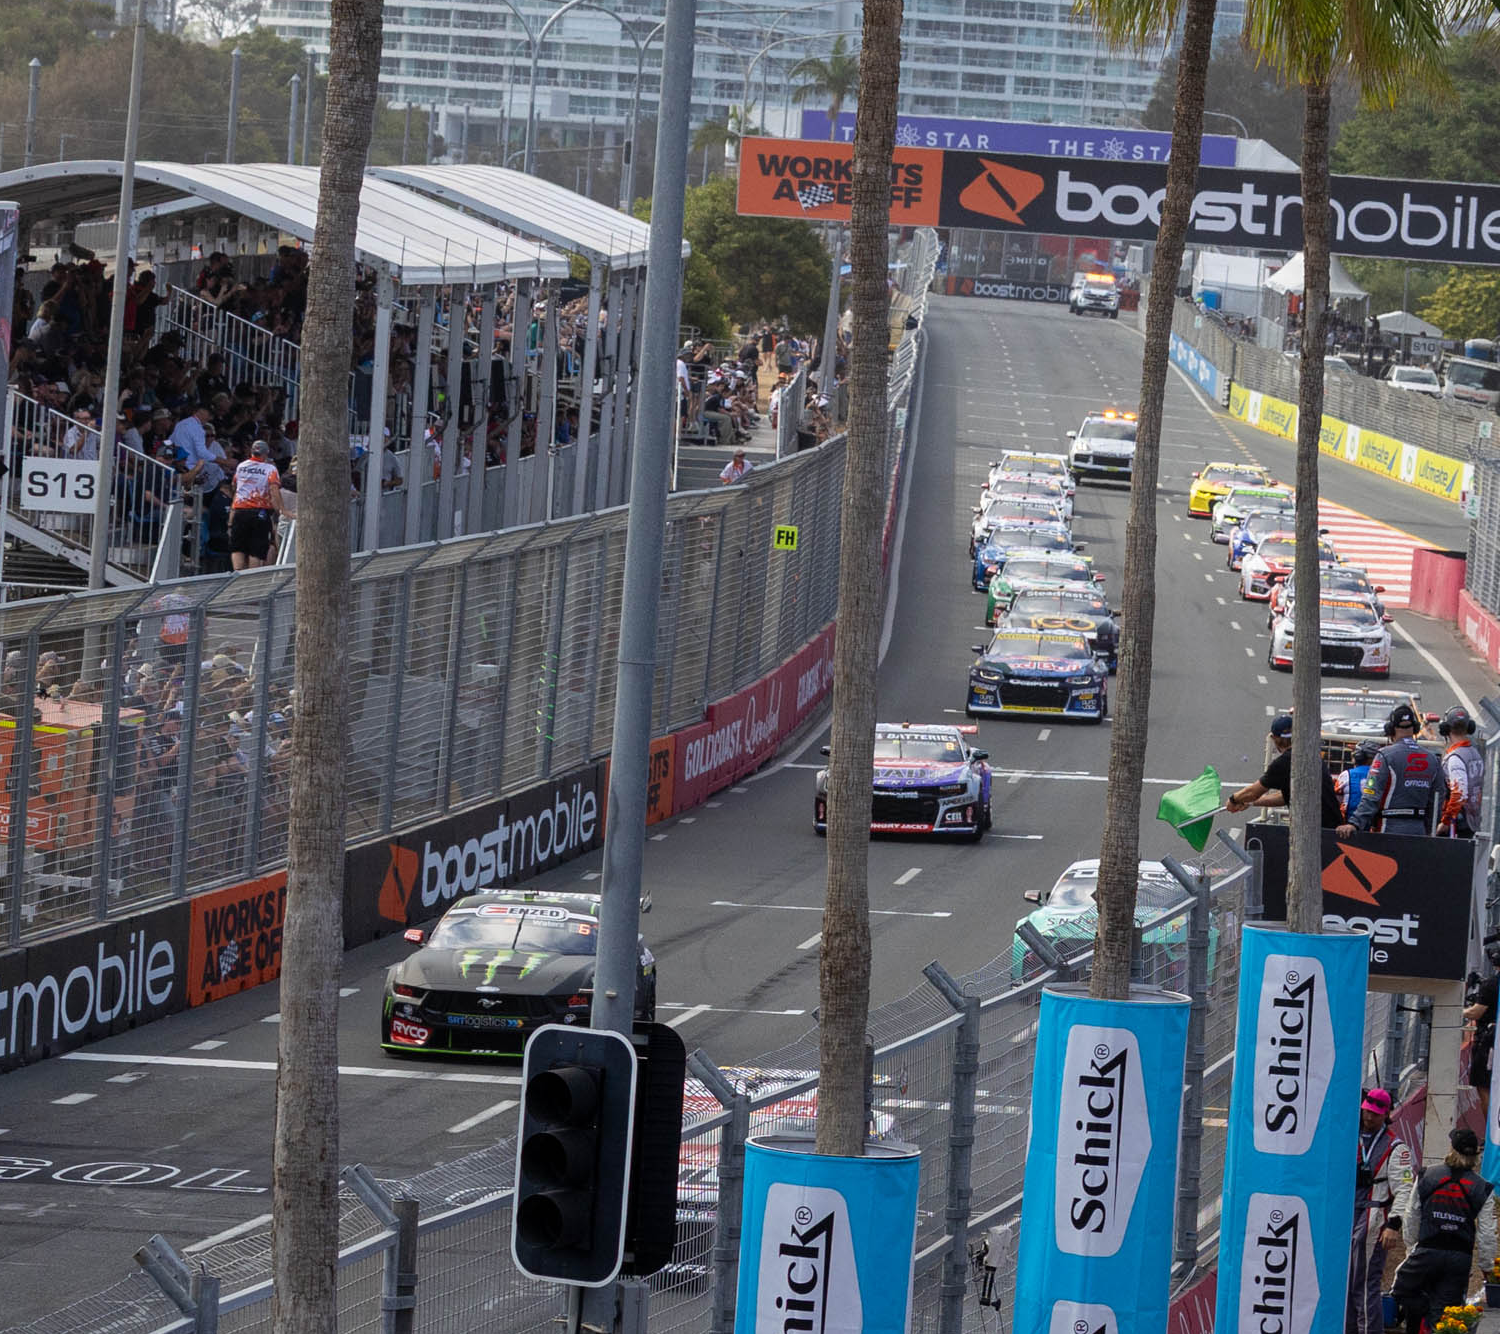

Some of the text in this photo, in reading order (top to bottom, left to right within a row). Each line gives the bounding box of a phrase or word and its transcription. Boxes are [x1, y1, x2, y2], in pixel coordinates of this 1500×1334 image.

[927, 132, 990, 150] STAR
[1049, 139, 1171, 162] THE ST
[757, 153, 923, 186] WORK TS
[889, 184, 922, 209] FF
[974, 280, 1070, 303] boostmobil
[27, 470, 95, 500] S13
[1418, 460, 1449, 486] ultimate
[776, 528, 795, 547] FH
[1404, 779, 1430, 788] OFFICIAL
[421, 782, 598, 908] boostmobile
[203, 890, 275, 947] WORKS
[508, 906, 560, 918] ENZED
[1323, 912, 1420, 946] ost
[255, 926, 283, 971] OF
[391, 1020, 429, 1040] RYCO
